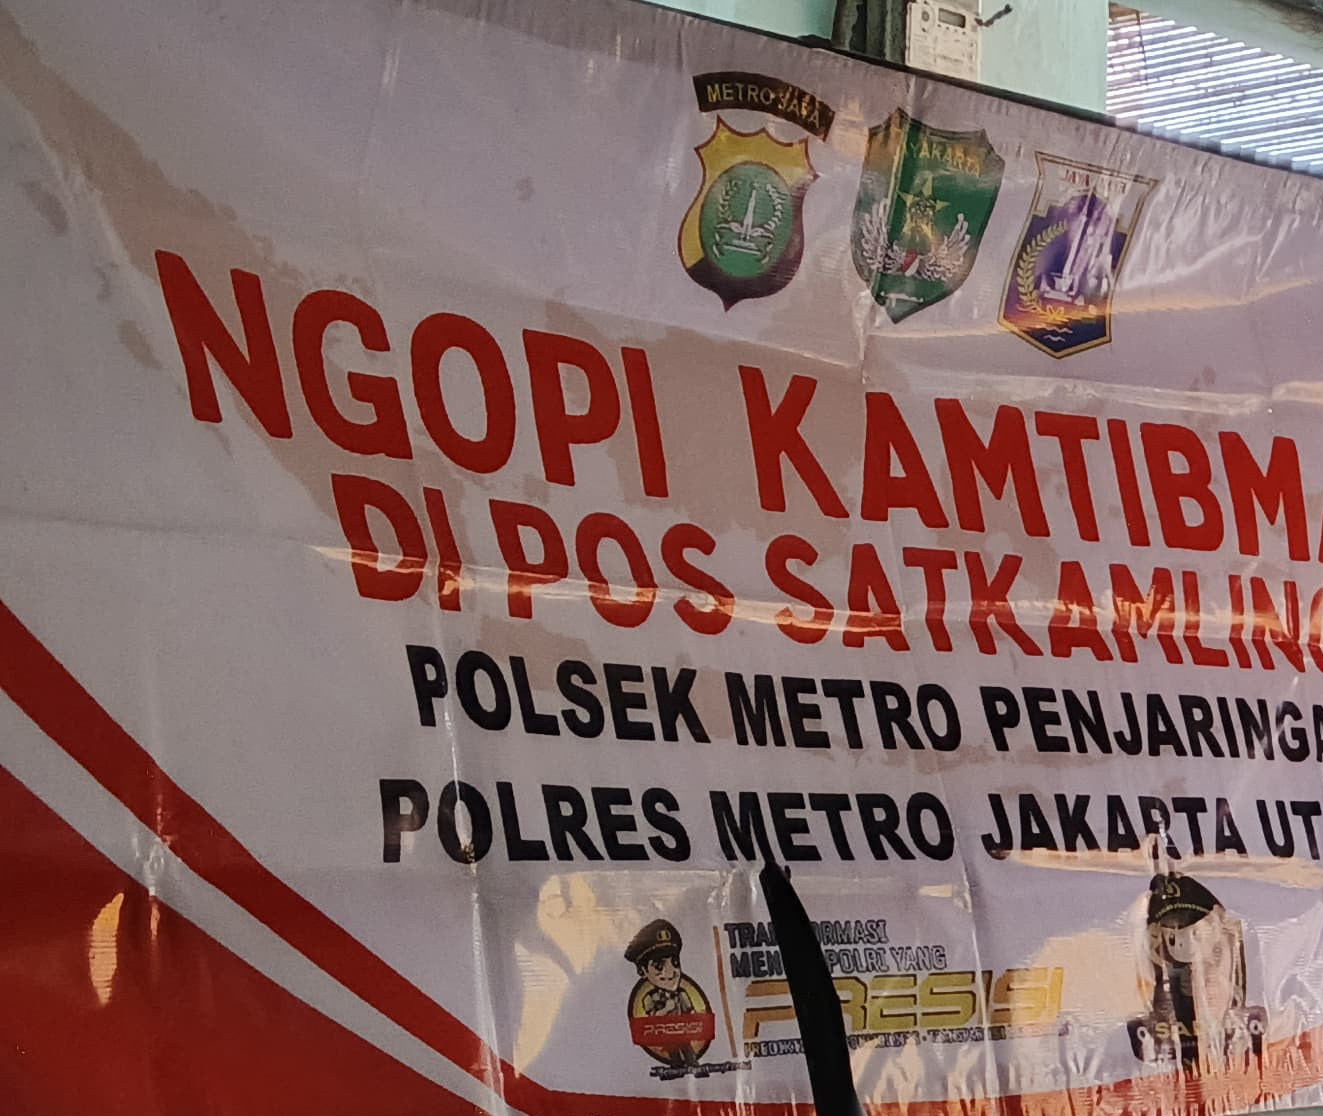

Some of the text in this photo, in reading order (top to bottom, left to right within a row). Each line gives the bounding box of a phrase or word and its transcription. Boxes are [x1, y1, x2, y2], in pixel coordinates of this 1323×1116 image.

[707, 82, 773, 105] METRO
[155, 250, 668, 498] NGOPI
[332, 474, 462, 612] DI
[489, 500, 736, 635] POS
[405, 644, 711, 743] POLSEK
[725, 671, 962, 752] METRO
[380, 779, 691, 863] POLRES
[709, 790, 955, 861] METRO
[981, 793, 1249, 861] JAKARTA
[731, 945, 948, 978] MEN POLRI YANG
